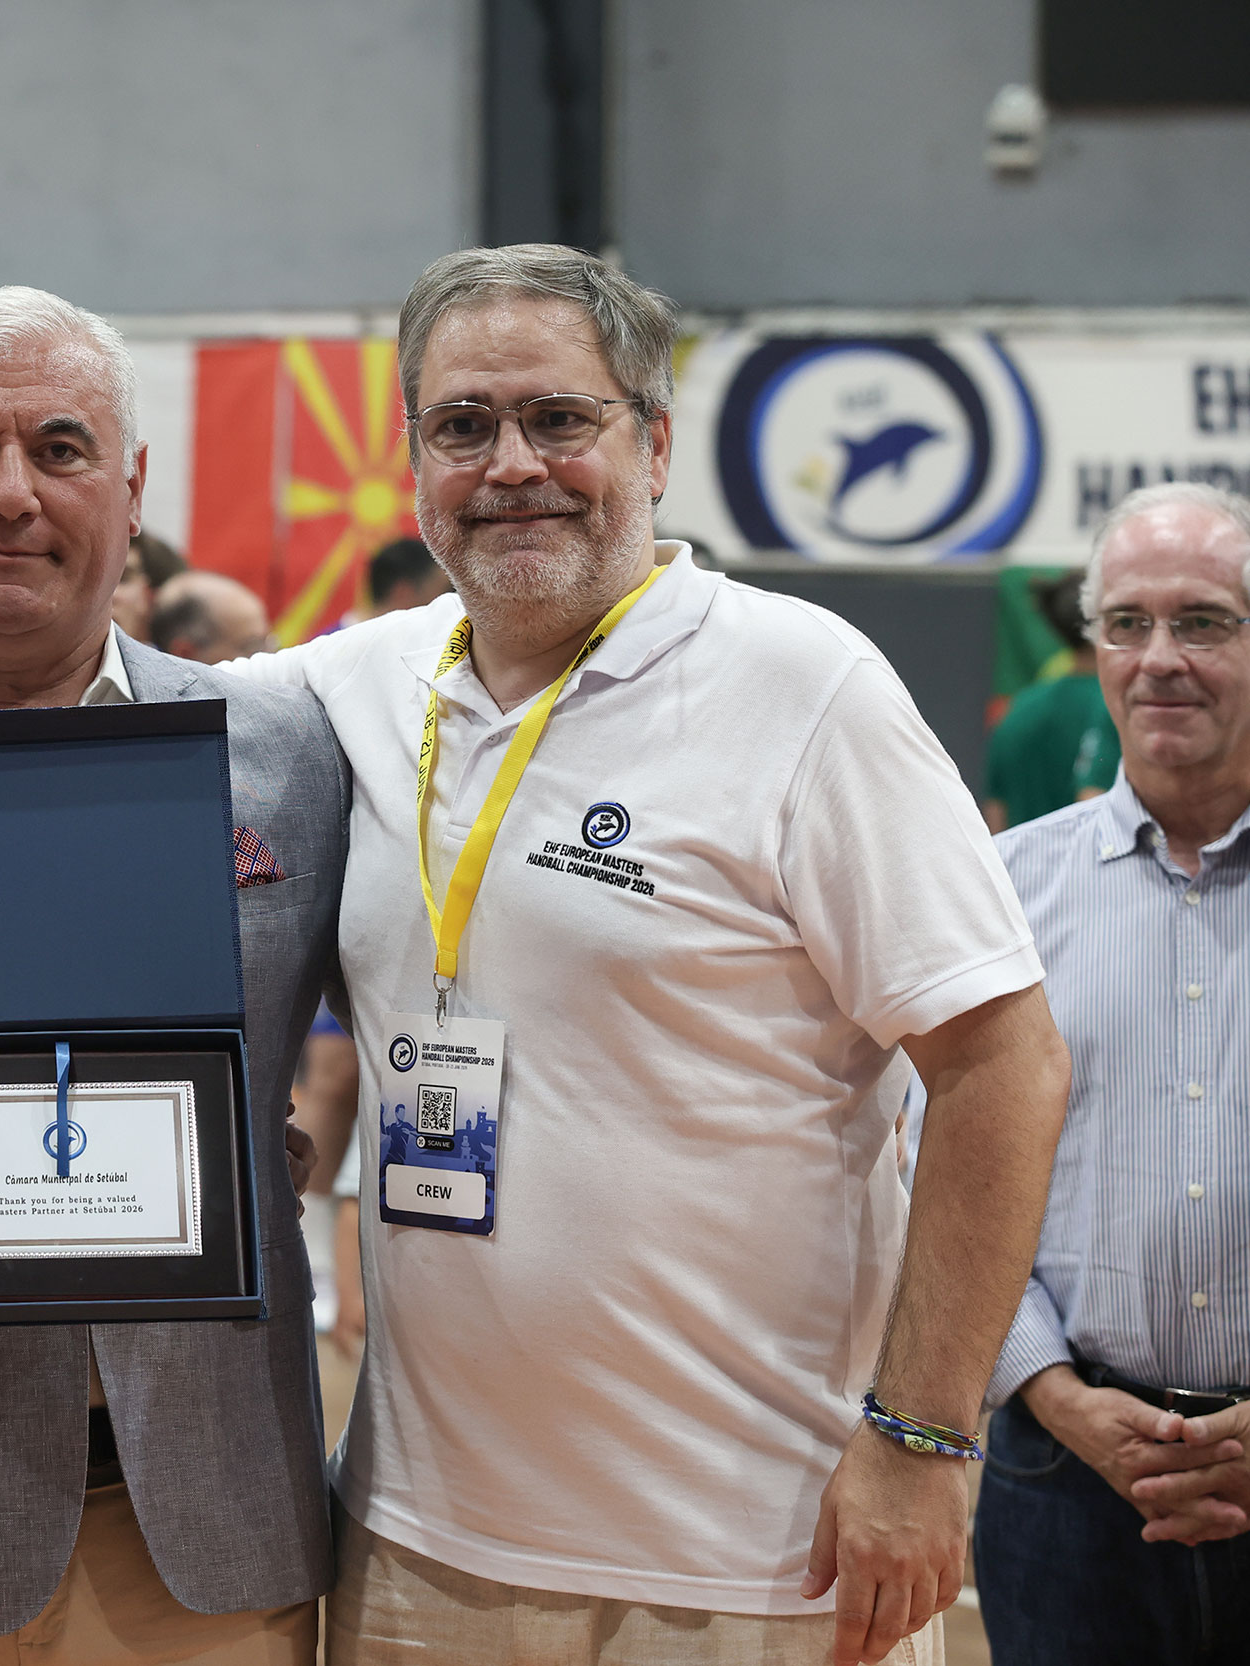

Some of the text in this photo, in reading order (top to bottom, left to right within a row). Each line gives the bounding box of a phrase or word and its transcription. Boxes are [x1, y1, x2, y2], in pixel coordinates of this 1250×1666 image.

[543, 840, 644, 877] EHF EUROPEAN MASTERS
[526, 852, 655, 897] HANDBALL CHAMPIONSHIP 2026
[422, 1043, 477, 1055] EHF EUROPEAN MASTERS
[422, 1052, 495, 1066] HANDBALL CHAMPIONSHIP 2026
[427, 1139, 442, 1147] SCAN
[84, 1173, 95, 1183] de
[96, 1171, 128, 1183] Setúbal
[416, 1183, 452, 1200] CREW
[31, 1198, 47, 1206] you
[51, 1196, 65, 1204] for
[68, 1196, 93, 1205] being
[106, 1195, 137, 1203] valued
[31, 1207, 65, 1215] Partner
[83, 1205, 117, 1214] Setúbal
[121, 1205, 144, 1213] 2026
